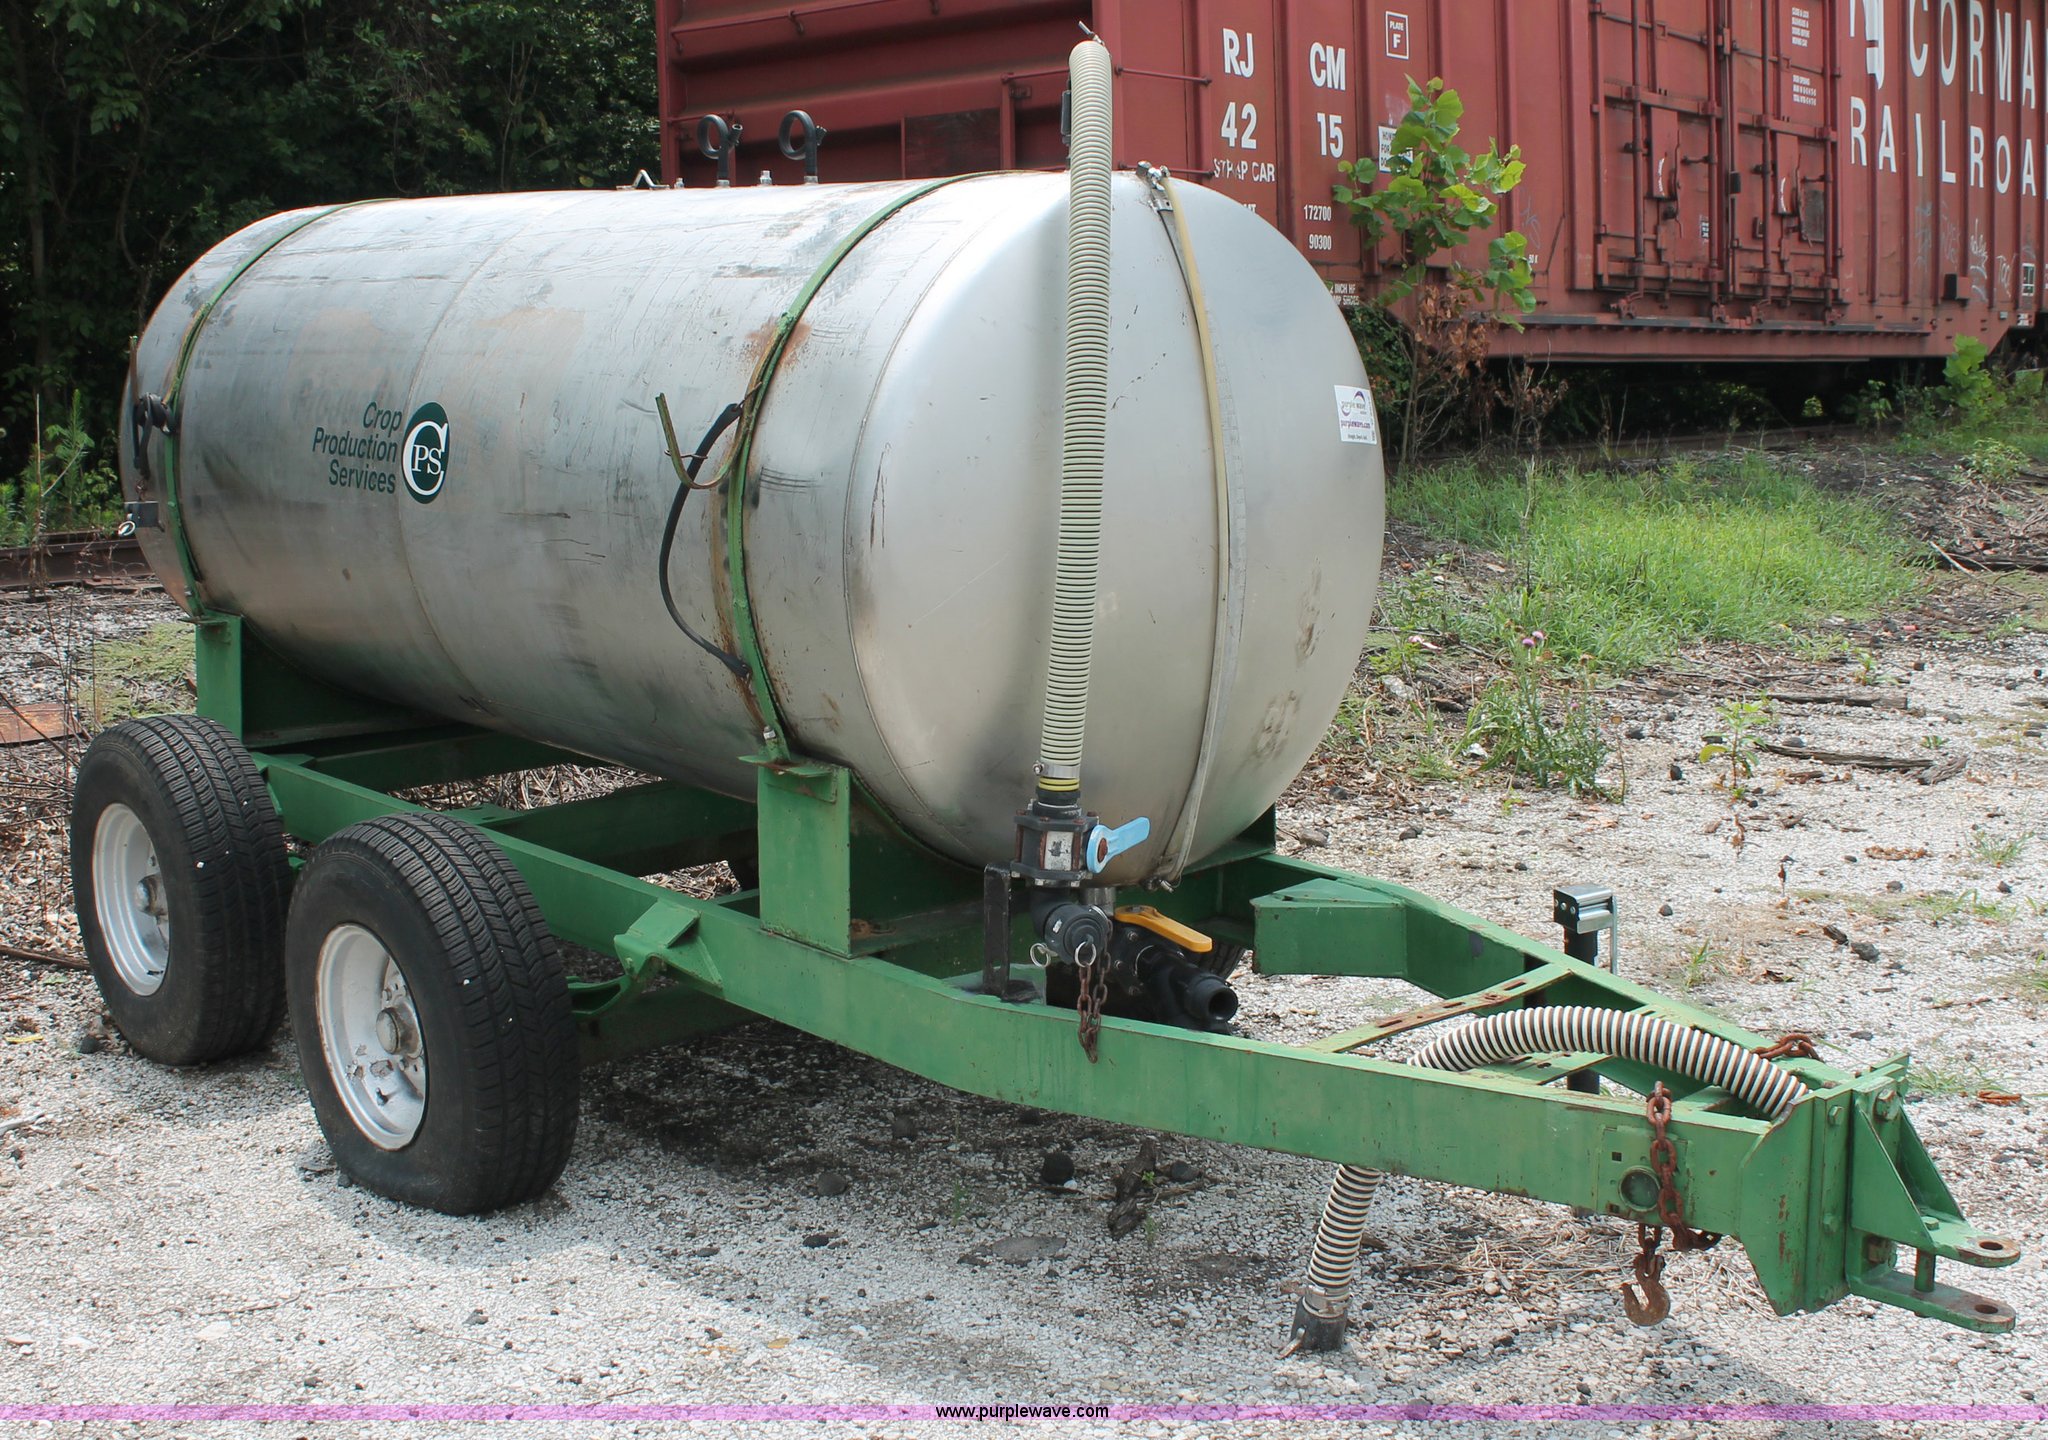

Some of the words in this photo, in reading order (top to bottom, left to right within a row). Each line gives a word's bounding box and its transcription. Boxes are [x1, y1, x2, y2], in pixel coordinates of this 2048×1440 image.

[1390, 21, 1405, 31] PLATE
[1393, 34, 1401, 49] F
[1222, 27, 1255, 79] RJ
[1309, 41, 1346, 91] CM
[1909, 0, 2048, 119] CORMA
[1221, 101, 1258, 150] 42
[1316, 112, 1344, 159] 15
[1850, 95, 2048, 201] RAILROA
[1252, 161, 1276, 183] CAR
[1303, 204, 1332, 222] 172700
[1308, 233, 1332, 251] 90300
[362, 401, 403, 438] Crop
[312, 427, 398, 463] Production
[328, 458, 397, 495] Services
